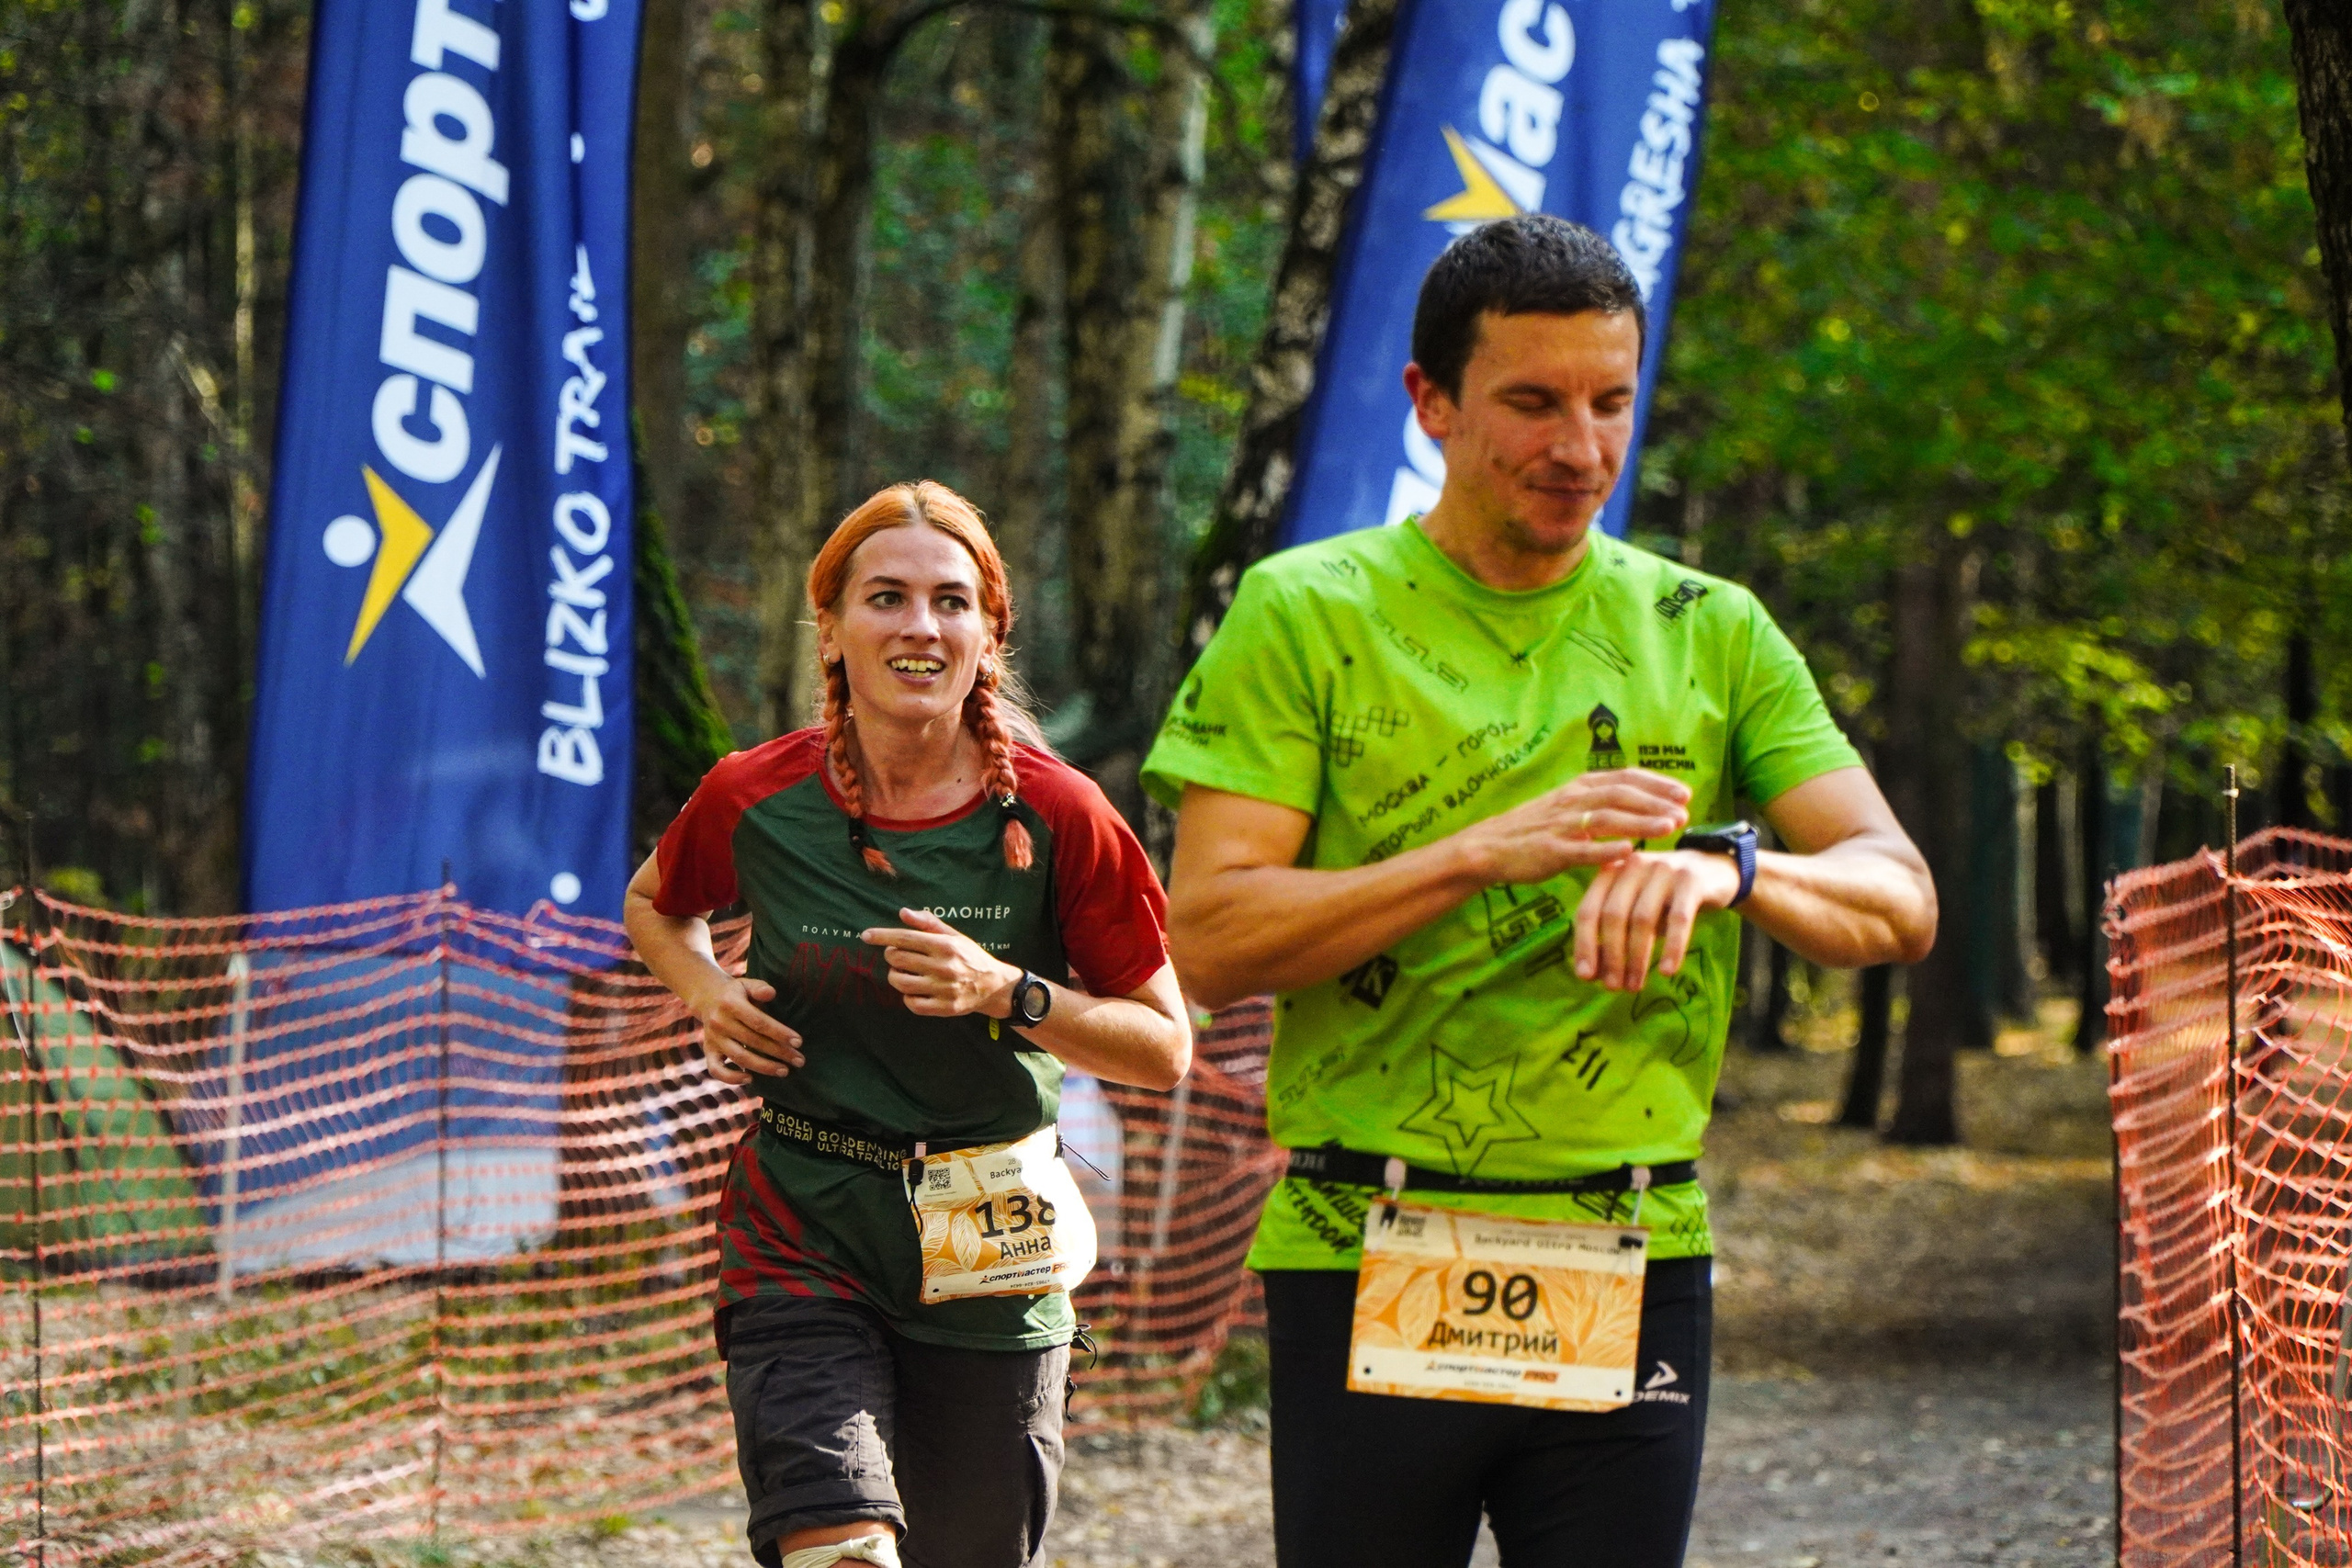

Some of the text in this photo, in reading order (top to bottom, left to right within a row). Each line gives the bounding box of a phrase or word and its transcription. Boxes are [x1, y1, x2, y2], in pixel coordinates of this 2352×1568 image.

[537, 491, 614, 786] BLIZKO
[817, 1142, 854, 1158] ULTRA
[1000, 1235, 1052, 1260] Анна
[1463, 1269, 1539, 1322] 90
[1427, 1321, 1558, 1357] Дмитрий
